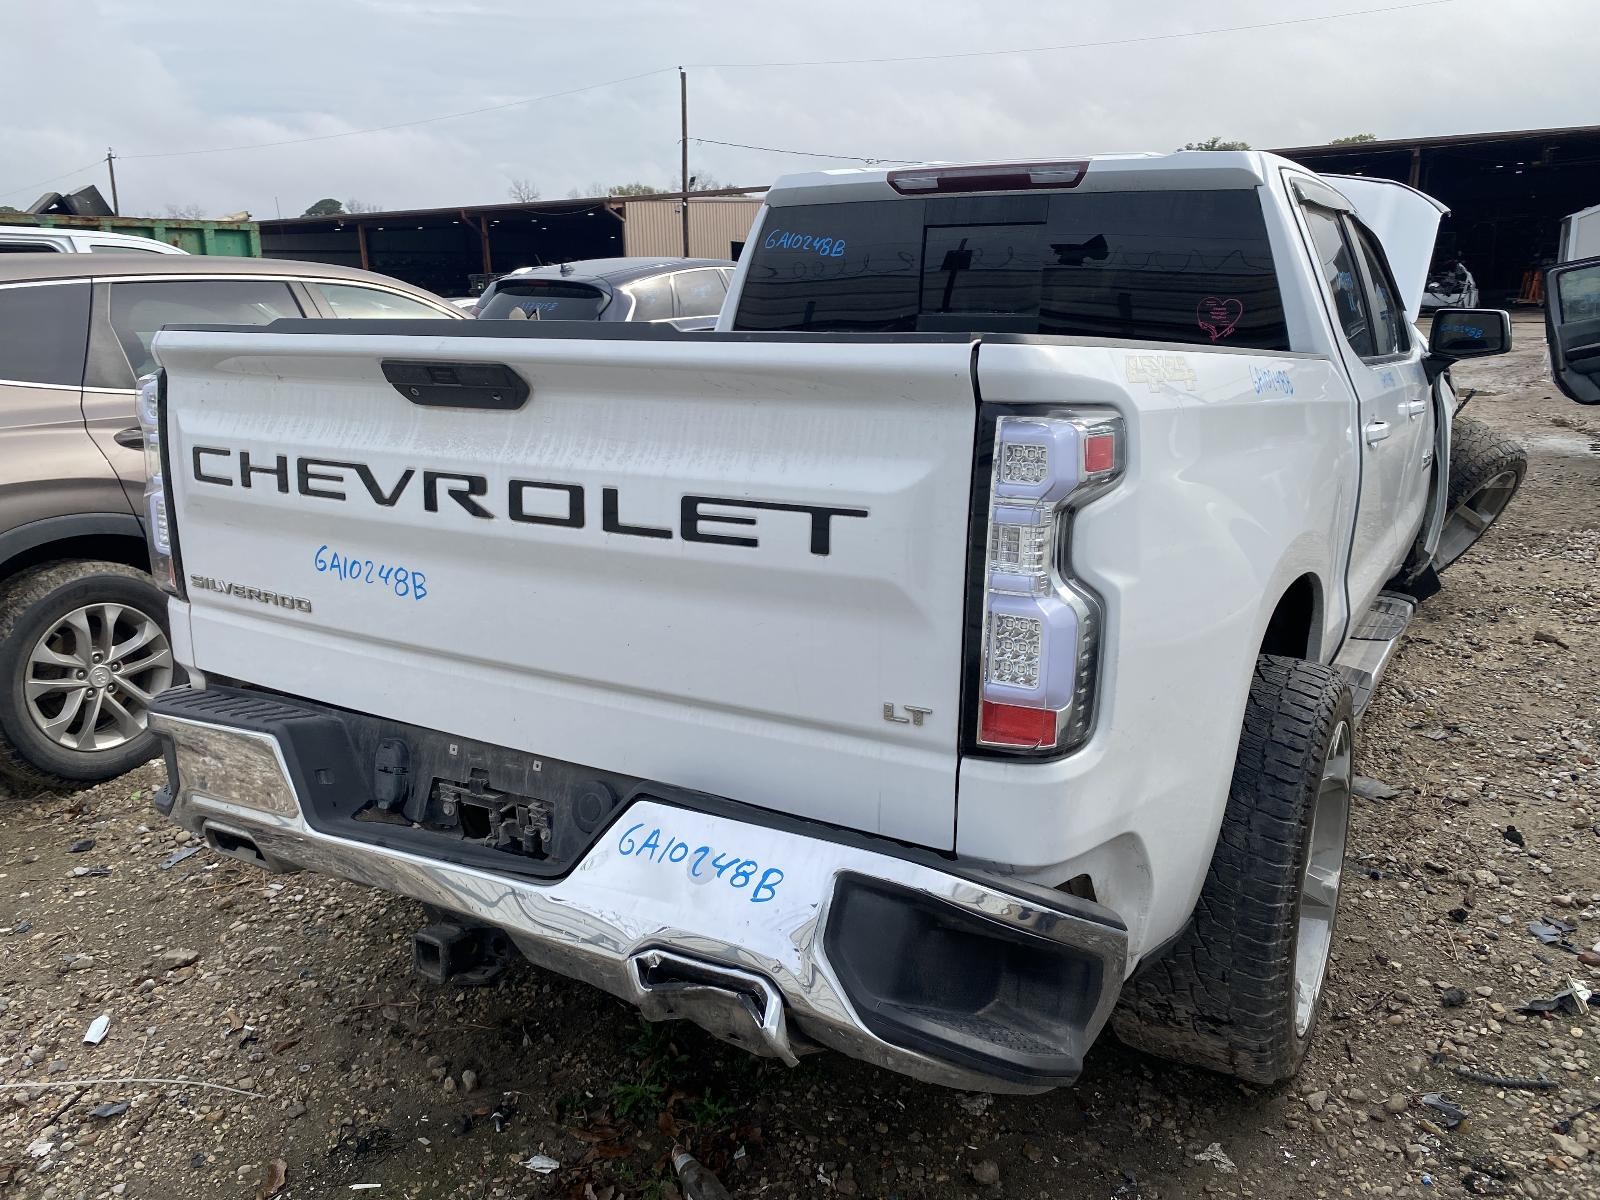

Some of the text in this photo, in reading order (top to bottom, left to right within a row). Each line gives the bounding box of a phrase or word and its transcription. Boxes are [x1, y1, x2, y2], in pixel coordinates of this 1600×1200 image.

[765, 229, 846, 257] 6A10248B
[193, 446, 868, 555] CHEVROLET
[190, 574, 312, 613] SILVERADO
[314, 545, 428, 600] 6A10248B
[883, 702, 933, 727] LT
[618, 823, 784, 903] 6A10248B
